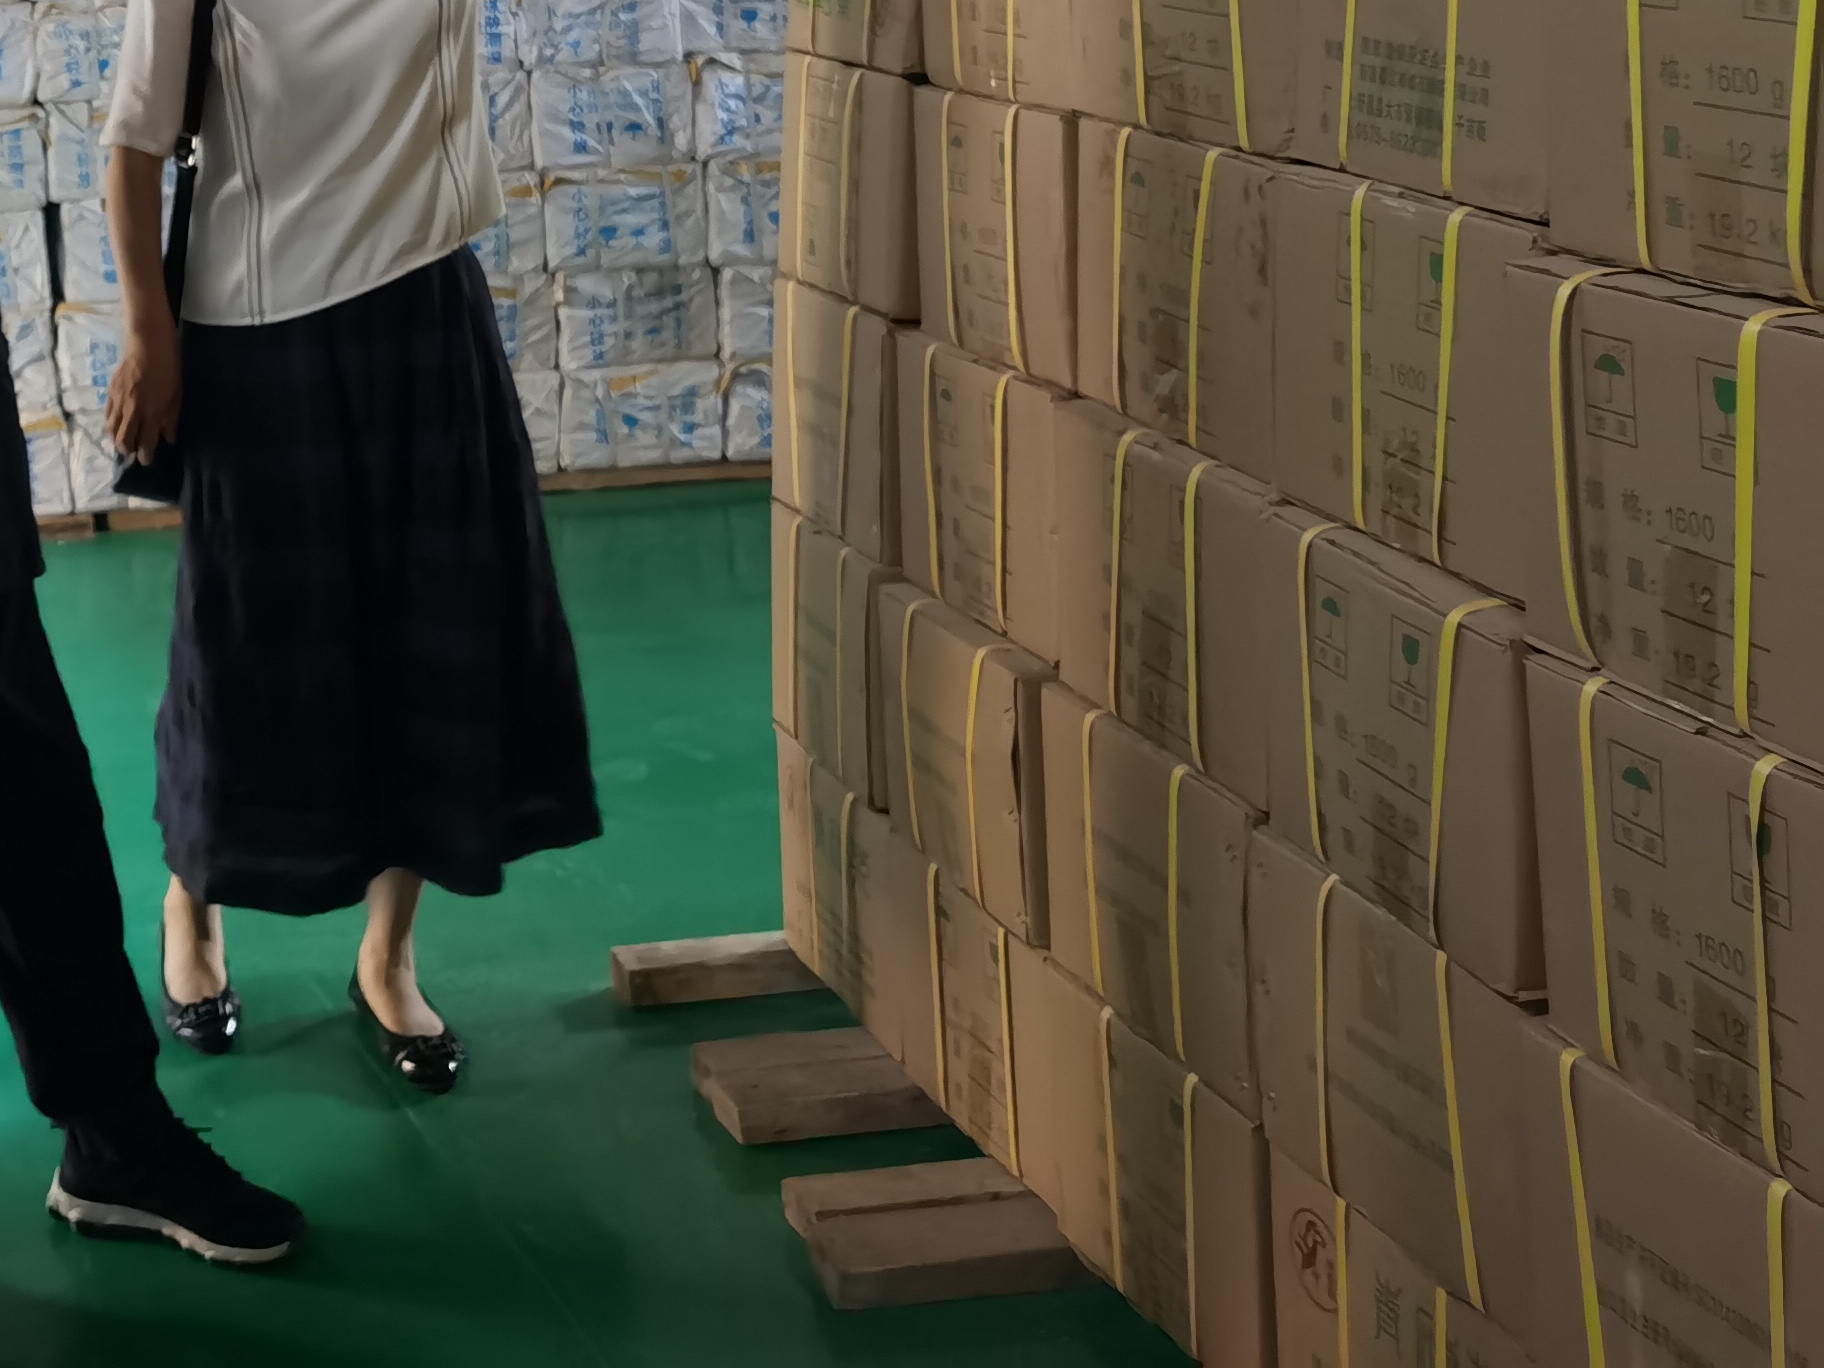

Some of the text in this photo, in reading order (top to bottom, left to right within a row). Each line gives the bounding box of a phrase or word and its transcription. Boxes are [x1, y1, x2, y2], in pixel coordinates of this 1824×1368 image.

[1705, 63, 1759, 96] 1600
[1726, 138, 1754, 169] 12
[1664, 506, 1716, 543] 1600
[1694, 931, 1747, 977] 1600
